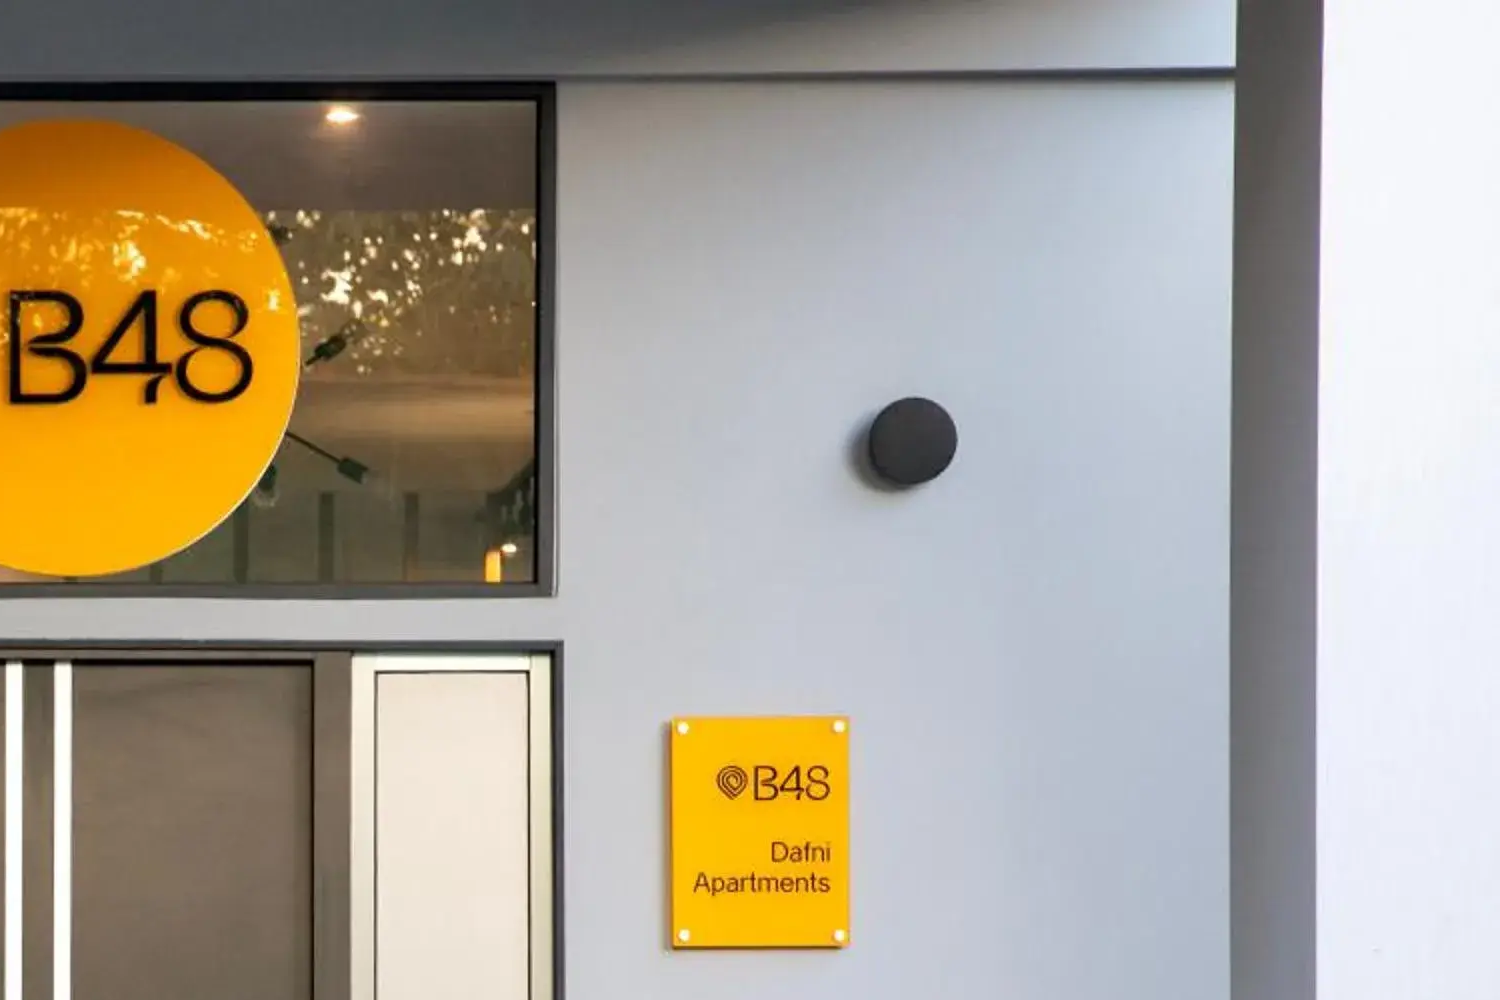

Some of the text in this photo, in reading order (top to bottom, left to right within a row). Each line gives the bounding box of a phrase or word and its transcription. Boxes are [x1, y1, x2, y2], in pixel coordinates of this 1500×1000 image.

[8, 288, 254, 405] B48
[753, 765, 831, 801] B48
[770, 841, 831, 863] Dafni
[693, 871, 831, 896] Apartments
